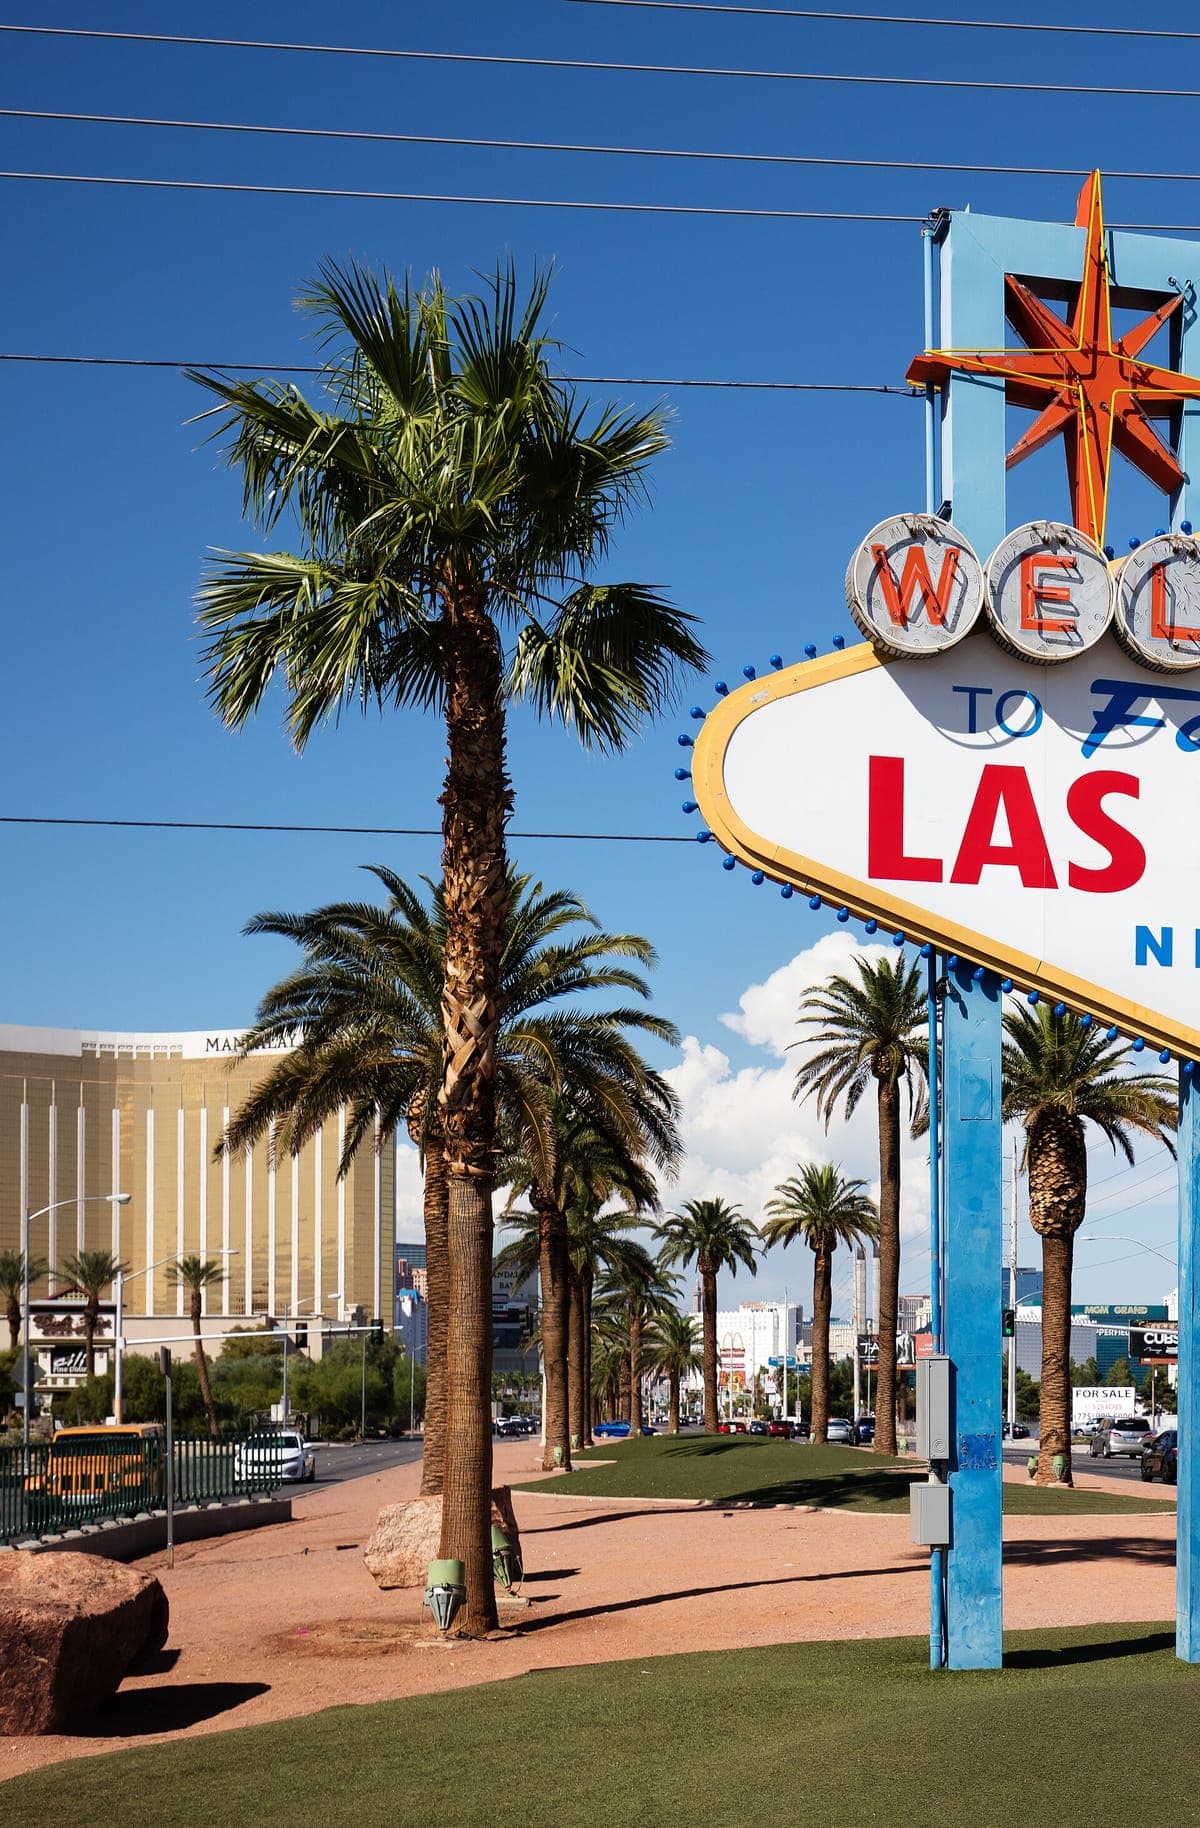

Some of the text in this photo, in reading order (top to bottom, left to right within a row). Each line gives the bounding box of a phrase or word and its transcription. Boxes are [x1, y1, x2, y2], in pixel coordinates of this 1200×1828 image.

[952, 685, 1043, 738] TO
[868, 755, 1146, 893] LAS
[1084, 1306, 1148, 1315] MGM GRAND
[1076, 1390, 1132, 1398] FOR SALE
